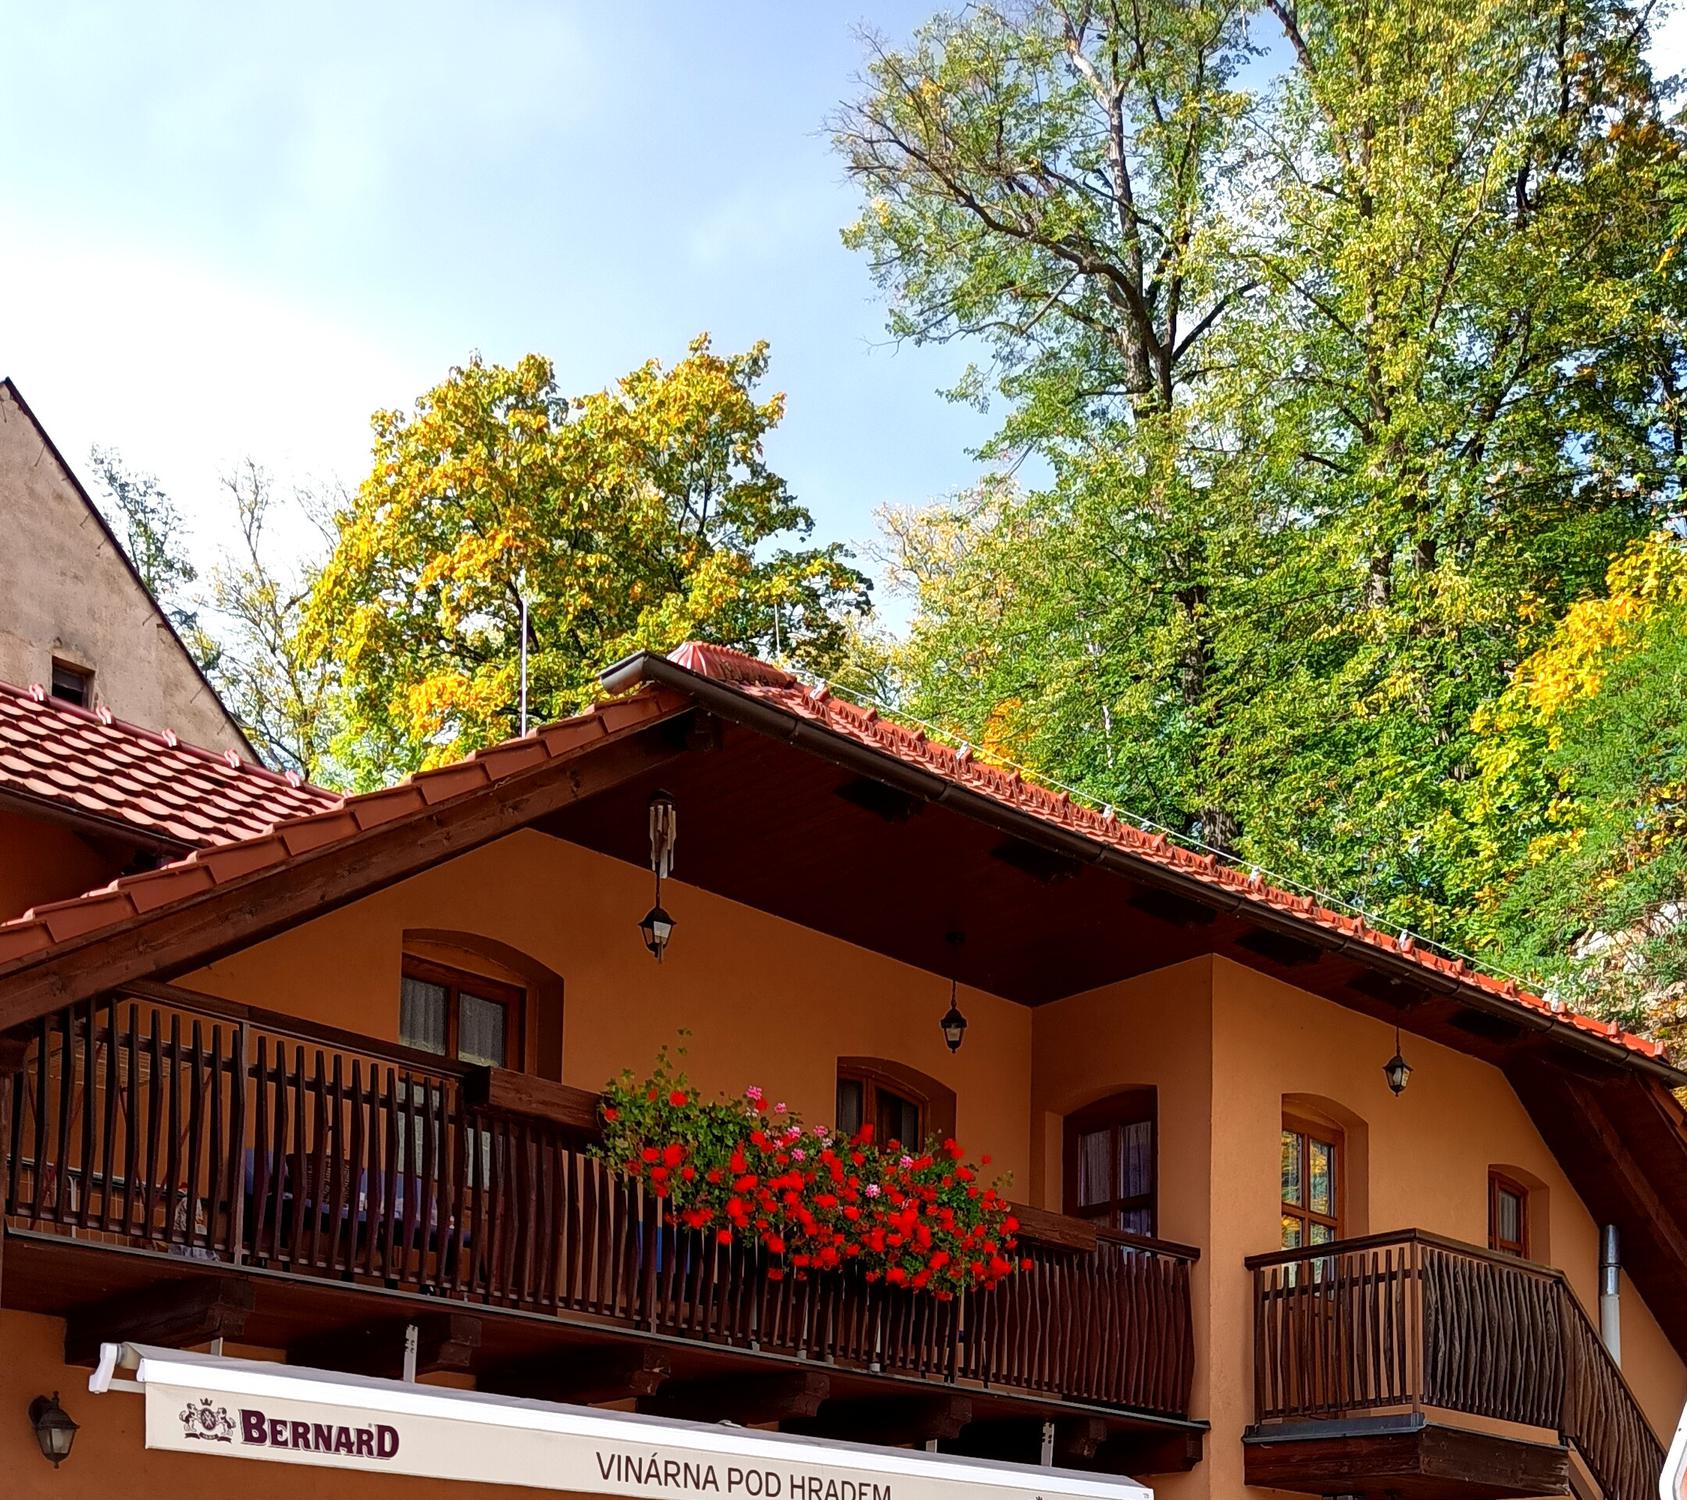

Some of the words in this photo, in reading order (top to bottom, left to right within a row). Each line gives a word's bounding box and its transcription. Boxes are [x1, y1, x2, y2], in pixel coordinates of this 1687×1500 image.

[238, 1409, 400, 1460] BERNARD
[596, 1451, 720, 1492] VINÁRNA
[727, 1467, 782, 1498] POD
